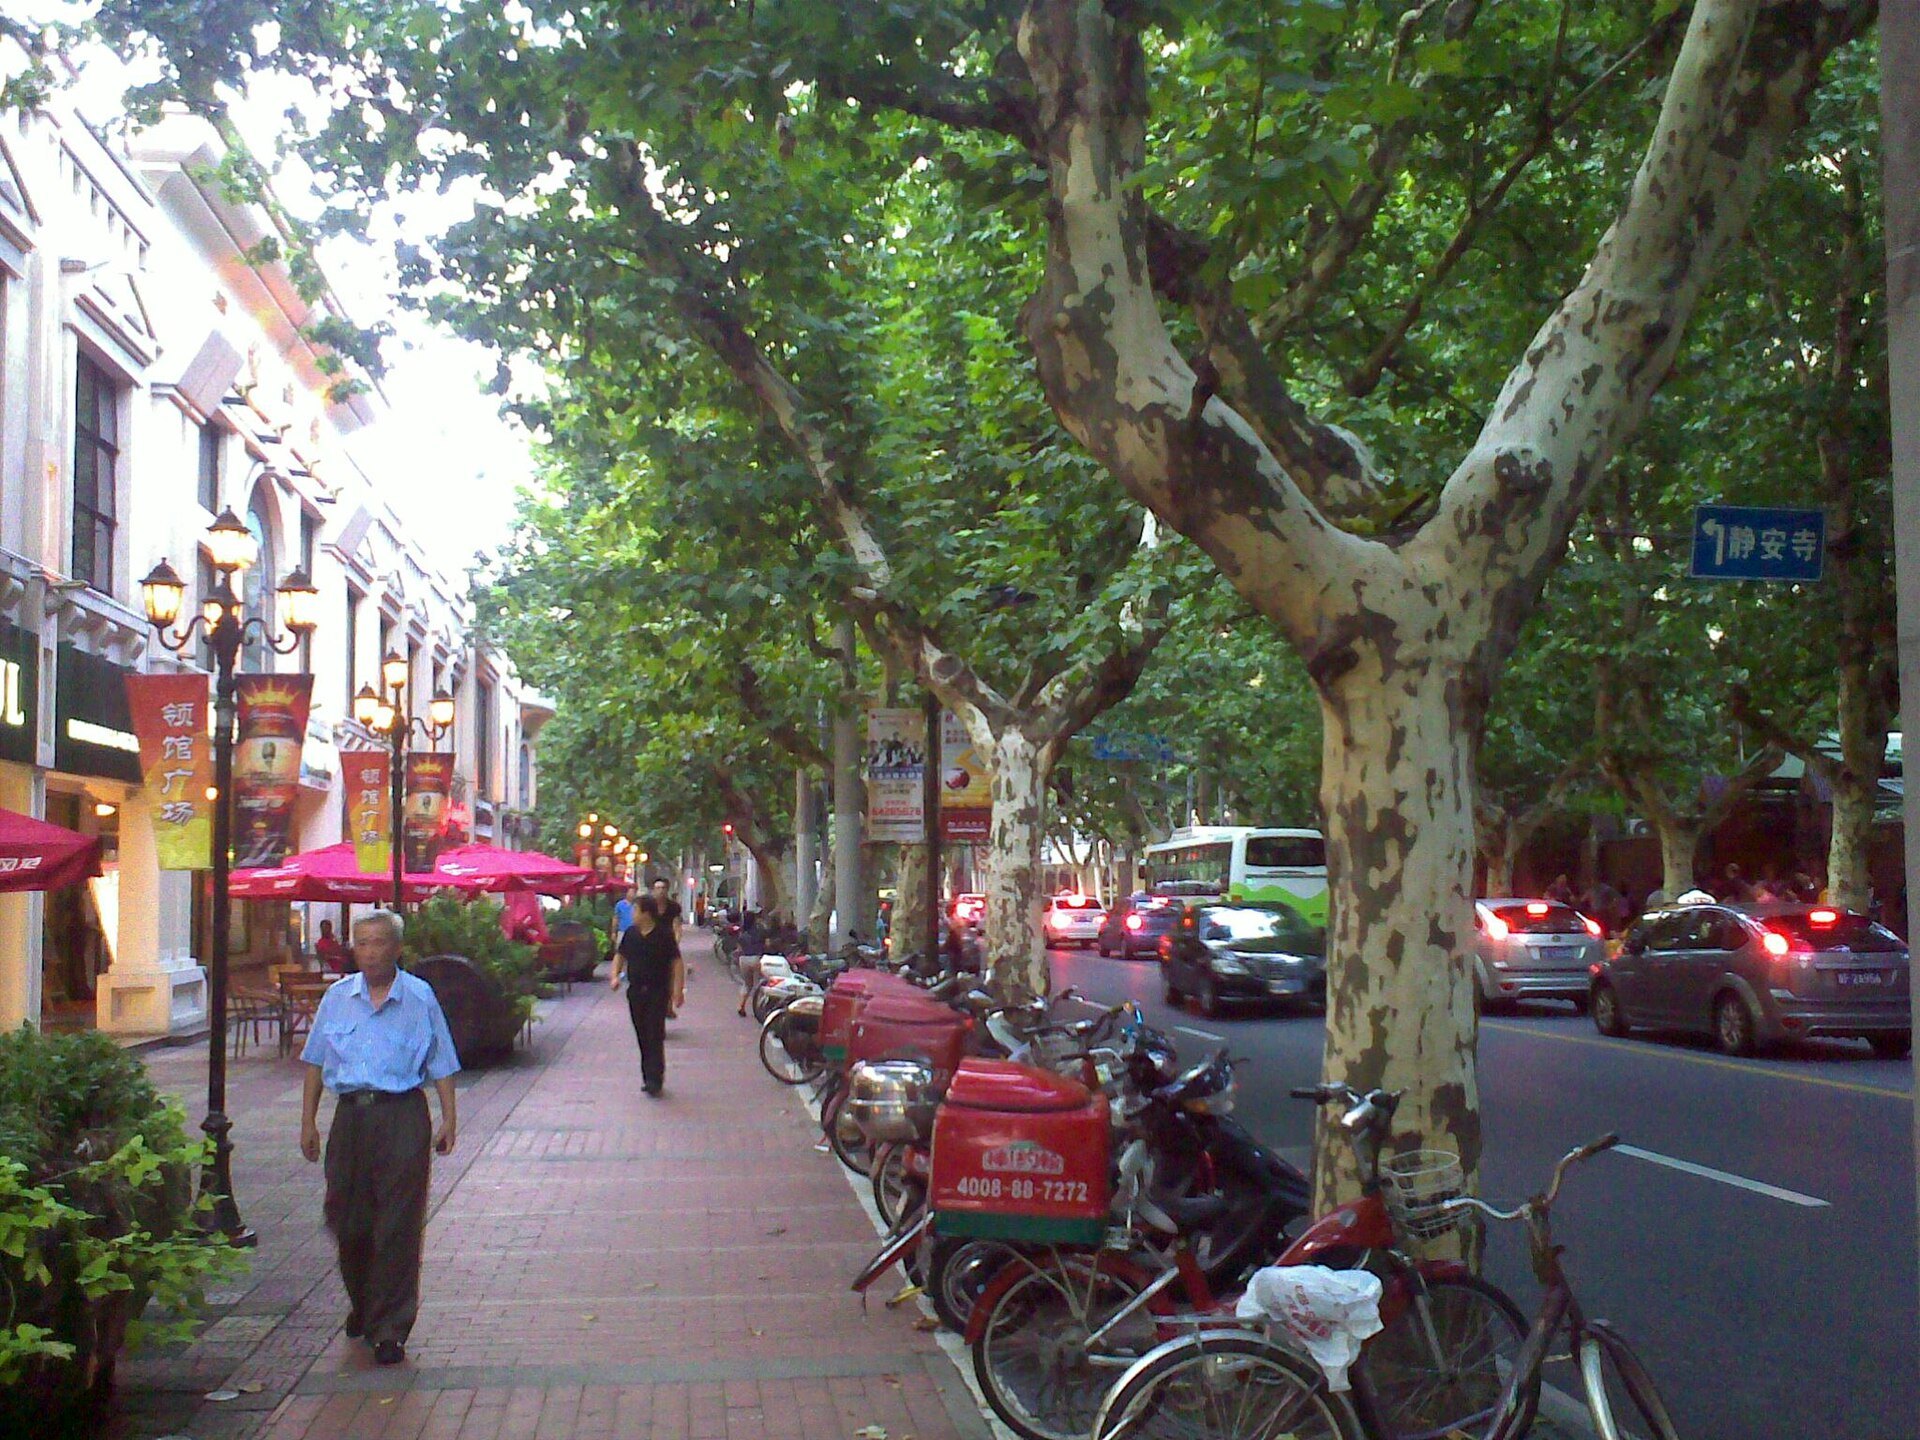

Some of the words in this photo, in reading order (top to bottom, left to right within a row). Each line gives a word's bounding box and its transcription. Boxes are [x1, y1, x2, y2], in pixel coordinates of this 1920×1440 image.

[1728, 525, 1817, 562] 静安寺
[161, 702, 195, 826] 领馆广场
[957, 1176, 1088, 1202] 4008-88-7272
